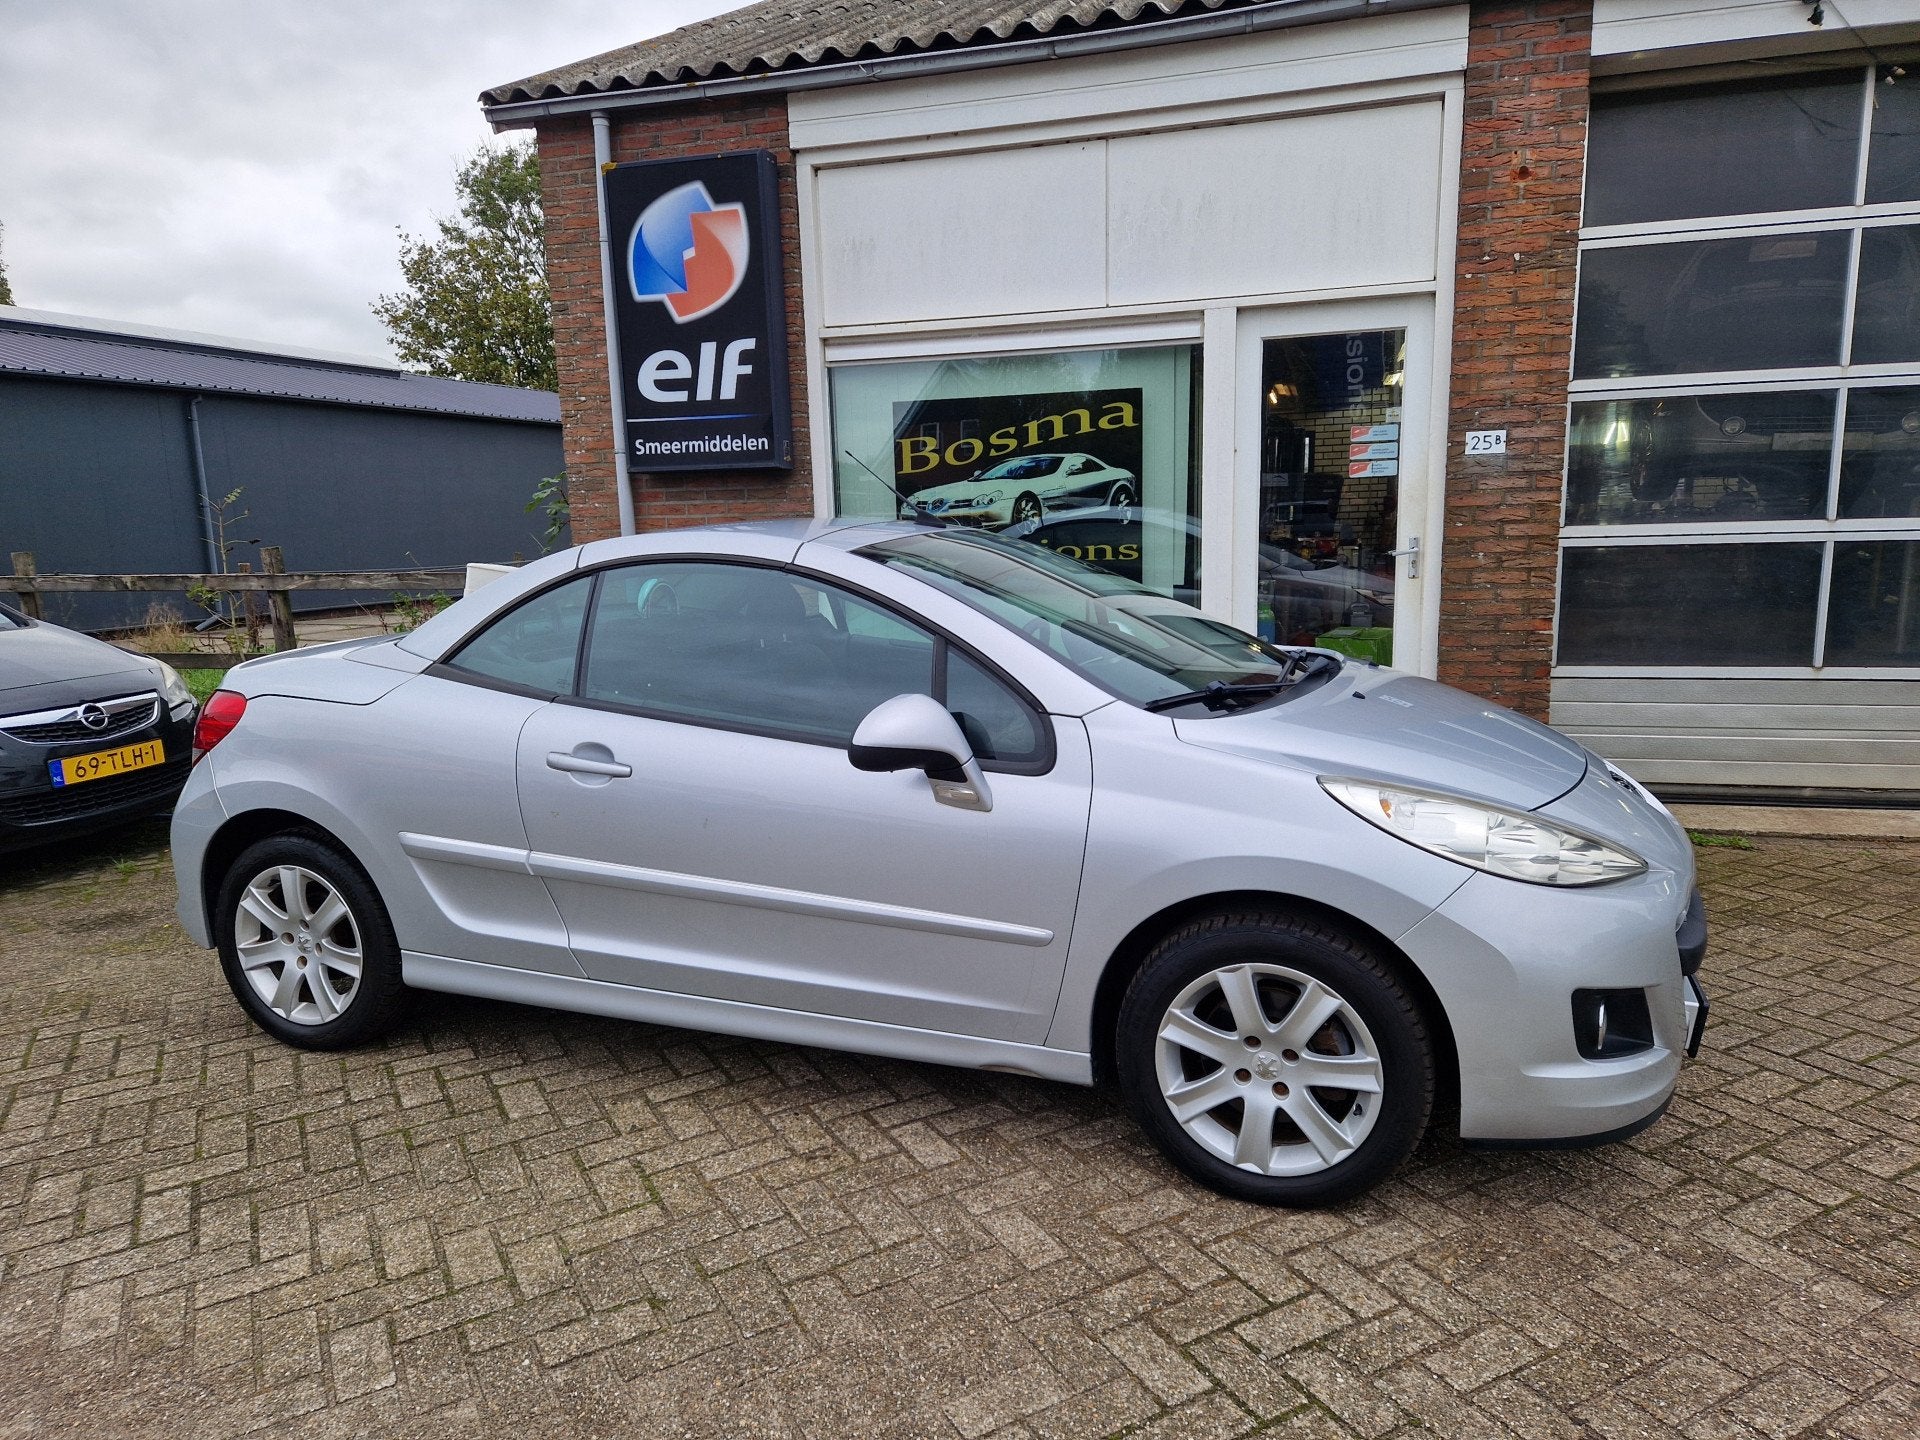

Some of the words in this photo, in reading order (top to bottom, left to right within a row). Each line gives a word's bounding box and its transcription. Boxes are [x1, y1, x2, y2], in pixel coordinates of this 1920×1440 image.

[637, 338, 757, 402] elf
[635, 434, 769, 456] Smeermiddelen
[896, 402, 1139, 475] Bosma
[1471, 434, 1502, 450] 25B
[75, 744, 156, 778] 69-TLH-1
